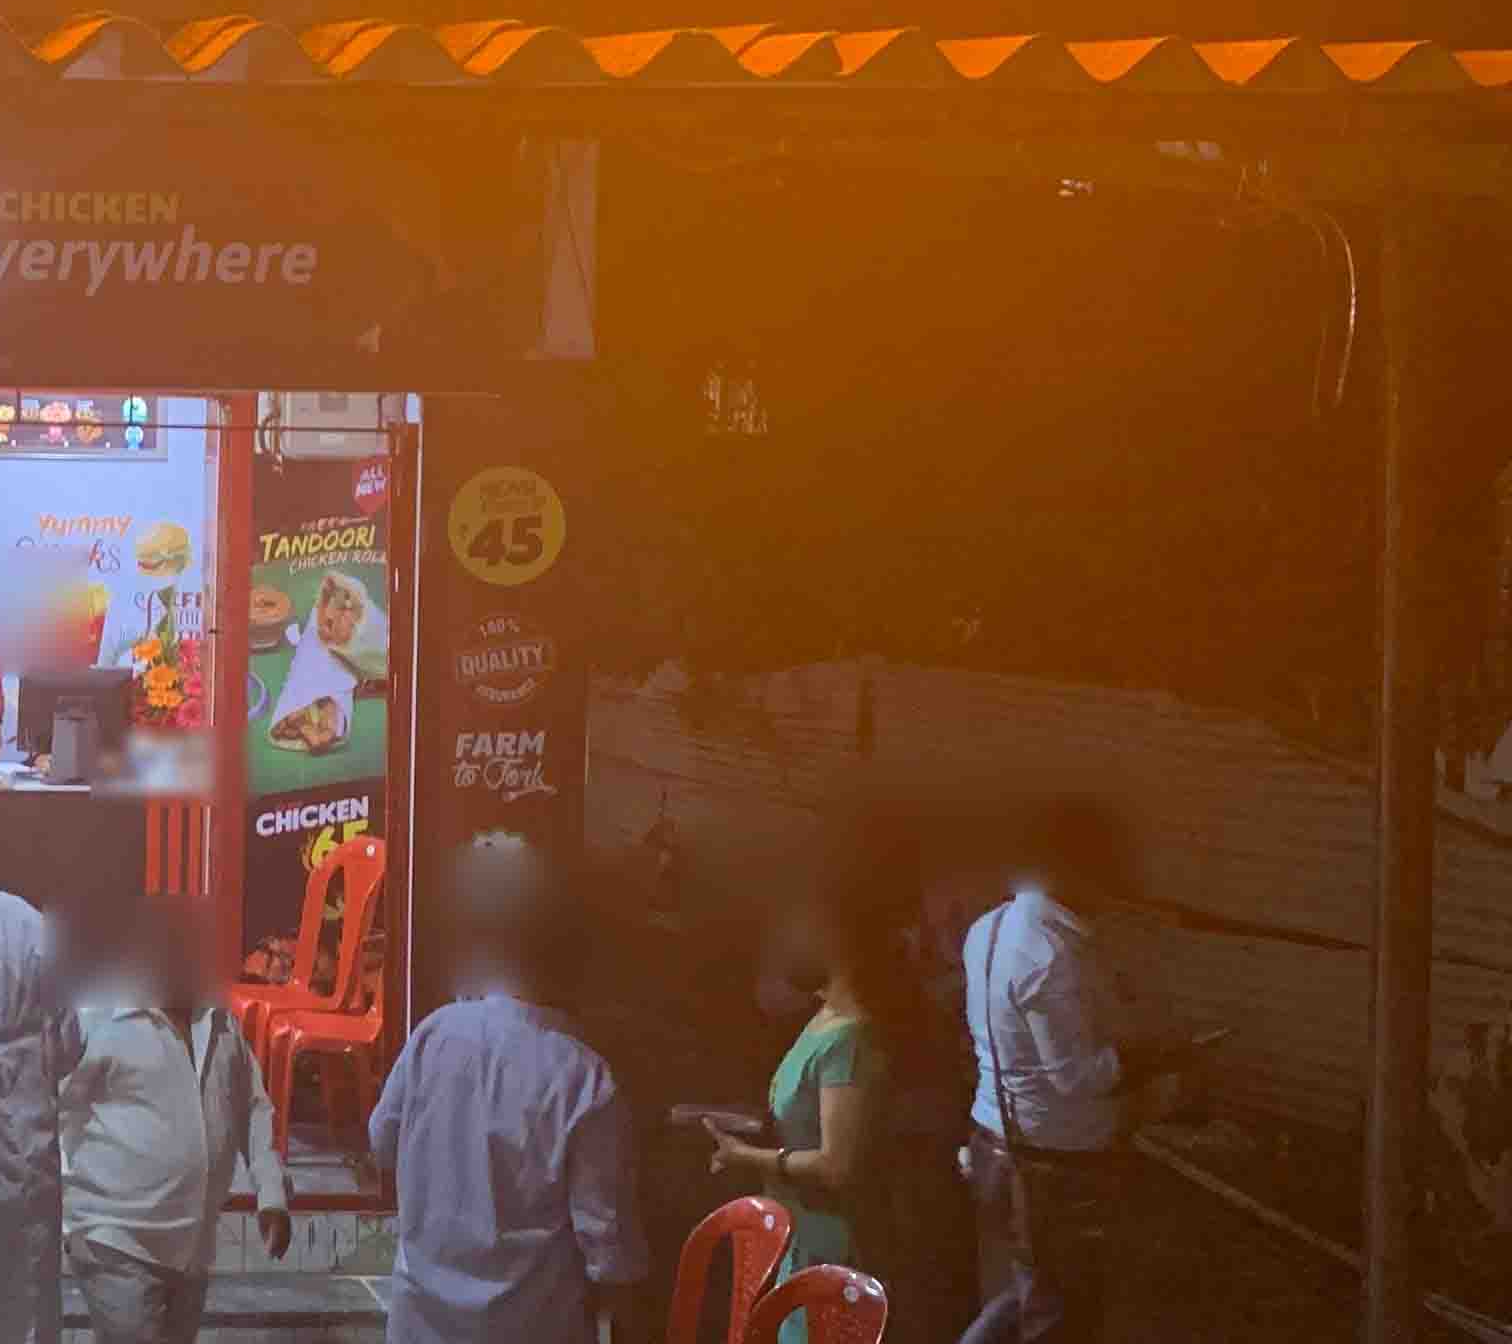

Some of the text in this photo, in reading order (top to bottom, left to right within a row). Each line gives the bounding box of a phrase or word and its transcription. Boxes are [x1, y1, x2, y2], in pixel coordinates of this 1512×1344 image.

[259, 524, 376, 563] TANDOORI
[289, 549, 348, 575] CHICKEN
[460, 645, 544, 678] QUALITY
[456, 730, 546, 757] FARM
[256, 795, 369, 838] CHICKEN
